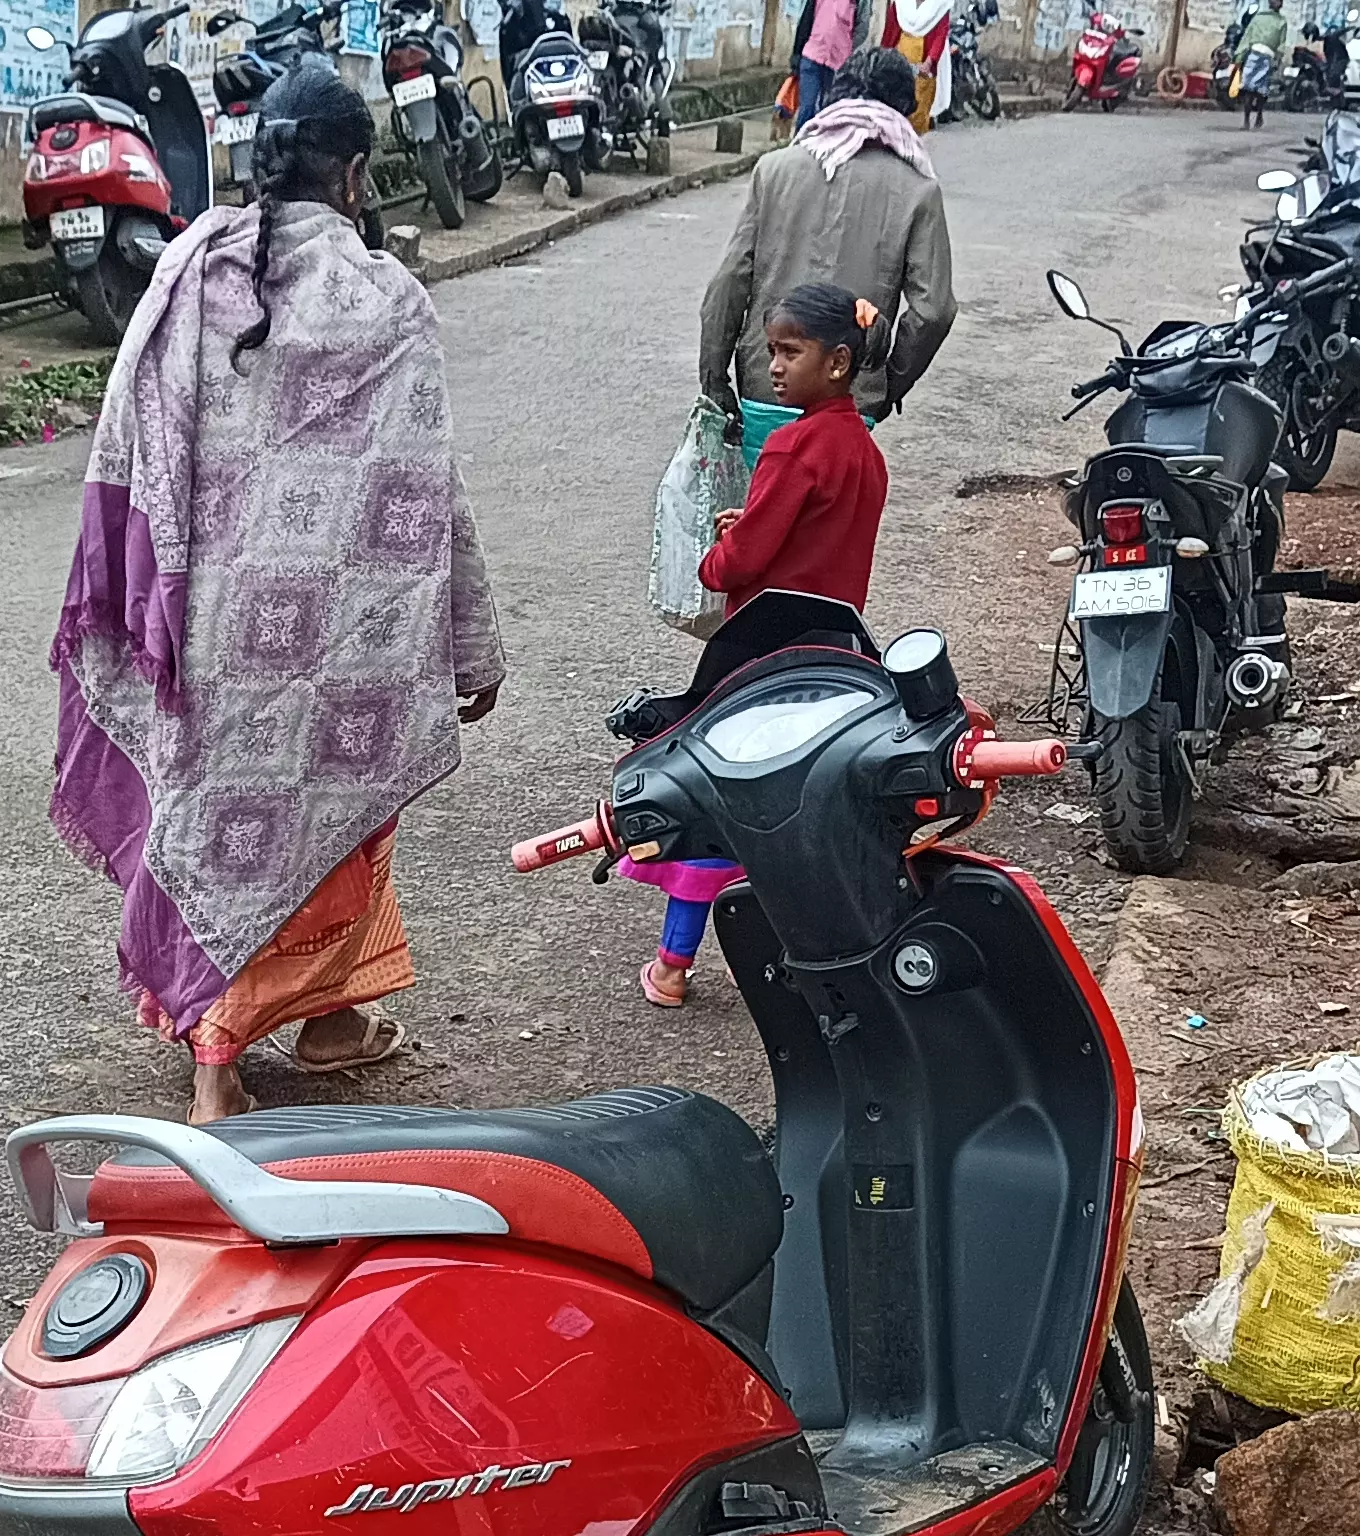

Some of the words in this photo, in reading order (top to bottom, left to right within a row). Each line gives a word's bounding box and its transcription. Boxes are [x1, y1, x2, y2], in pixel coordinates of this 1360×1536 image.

[1092, 579, 1117, 593] TN
[1123, 576, 1152, 592] 36
[1077, 598, 1111, 613] AM
[323, 1458, 573, 1518] Jupiter
